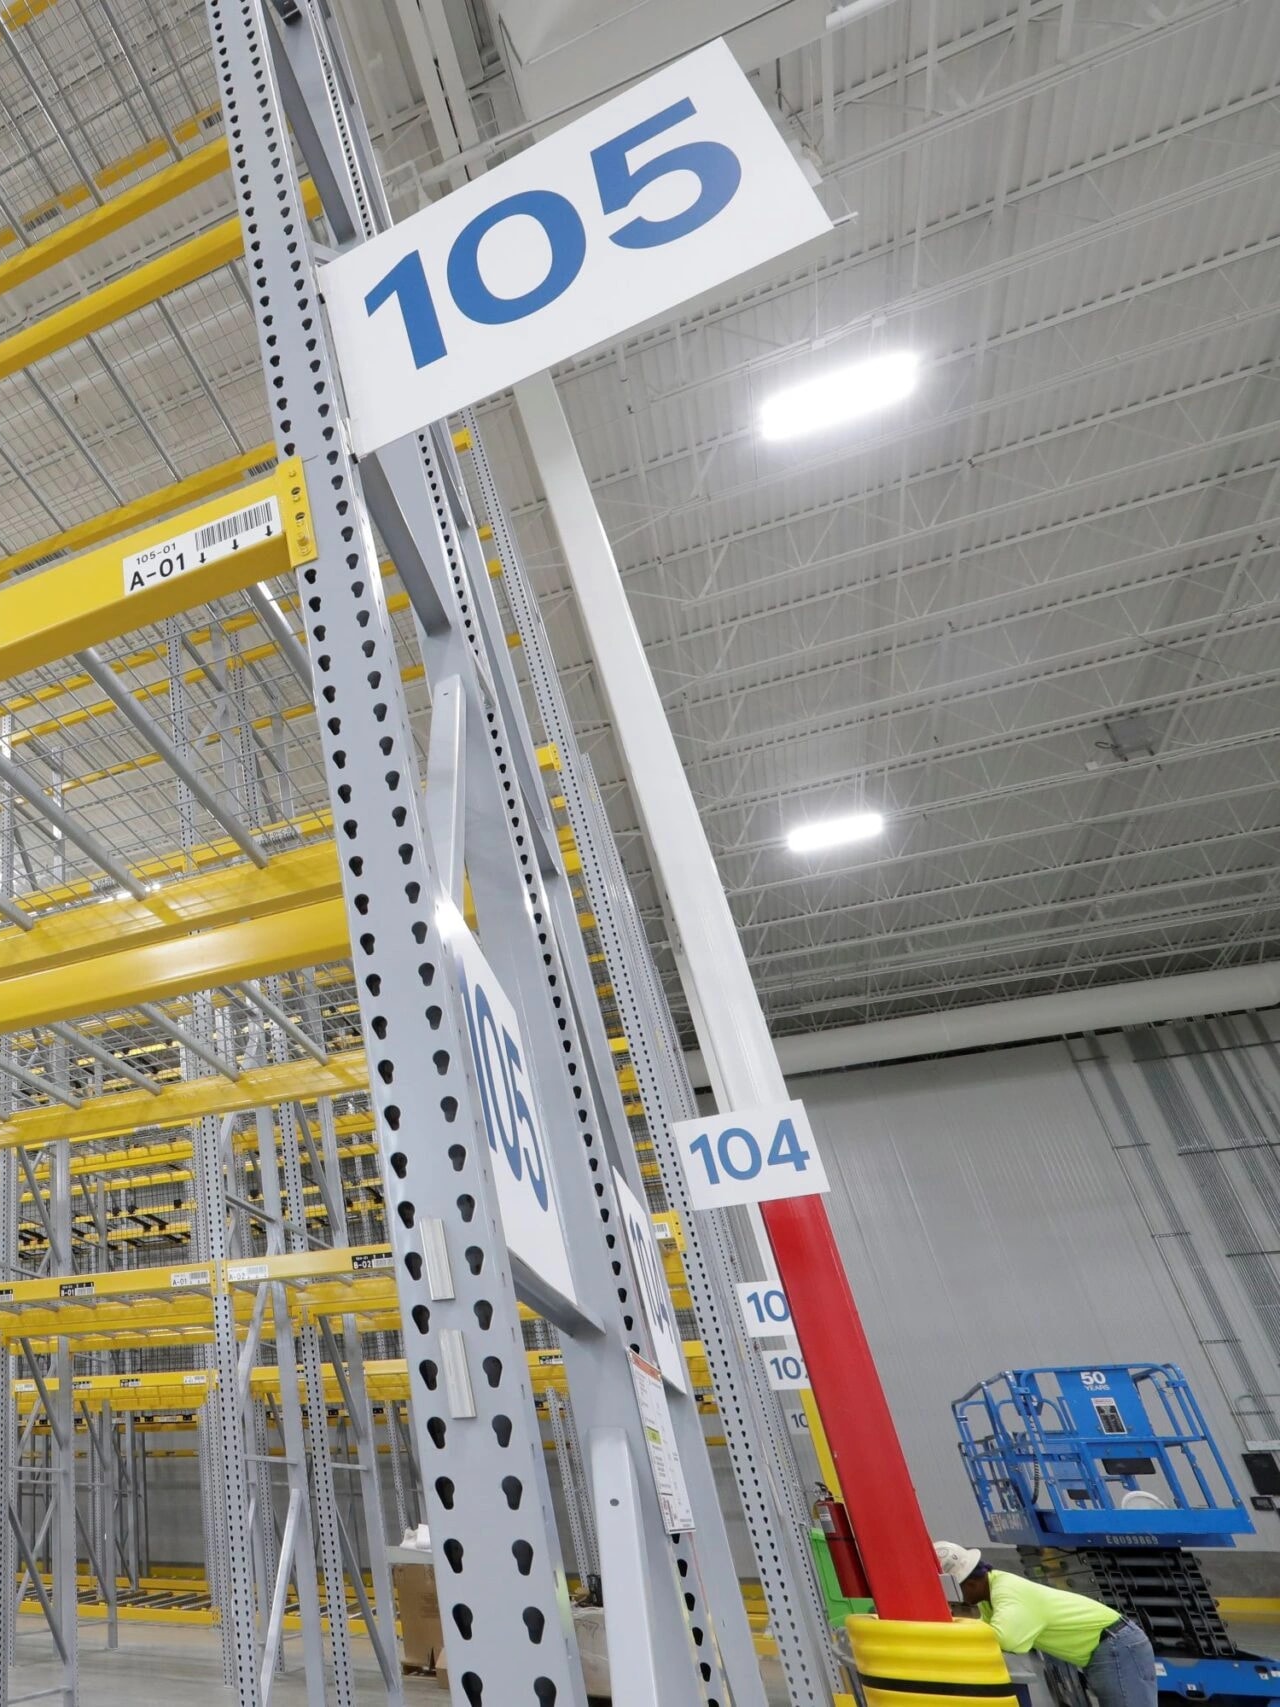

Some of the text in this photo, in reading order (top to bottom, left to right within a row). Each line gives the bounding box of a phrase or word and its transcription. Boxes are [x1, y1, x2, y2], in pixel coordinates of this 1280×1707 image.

[364, 96, 742, 370] 105
[136, 543, 176, 565] 105-01
[130, 553, 185, 591] A-01
[455, 953, 549, 1213] 105
[689, 1118, 810, 1185] 104
[746, 1289, 790, 1323] 10
[770, 1356, 809, 1380] 10
[1080, 1371, 1106, 1385] 50
[791, 1412, 809, 1428] 10
